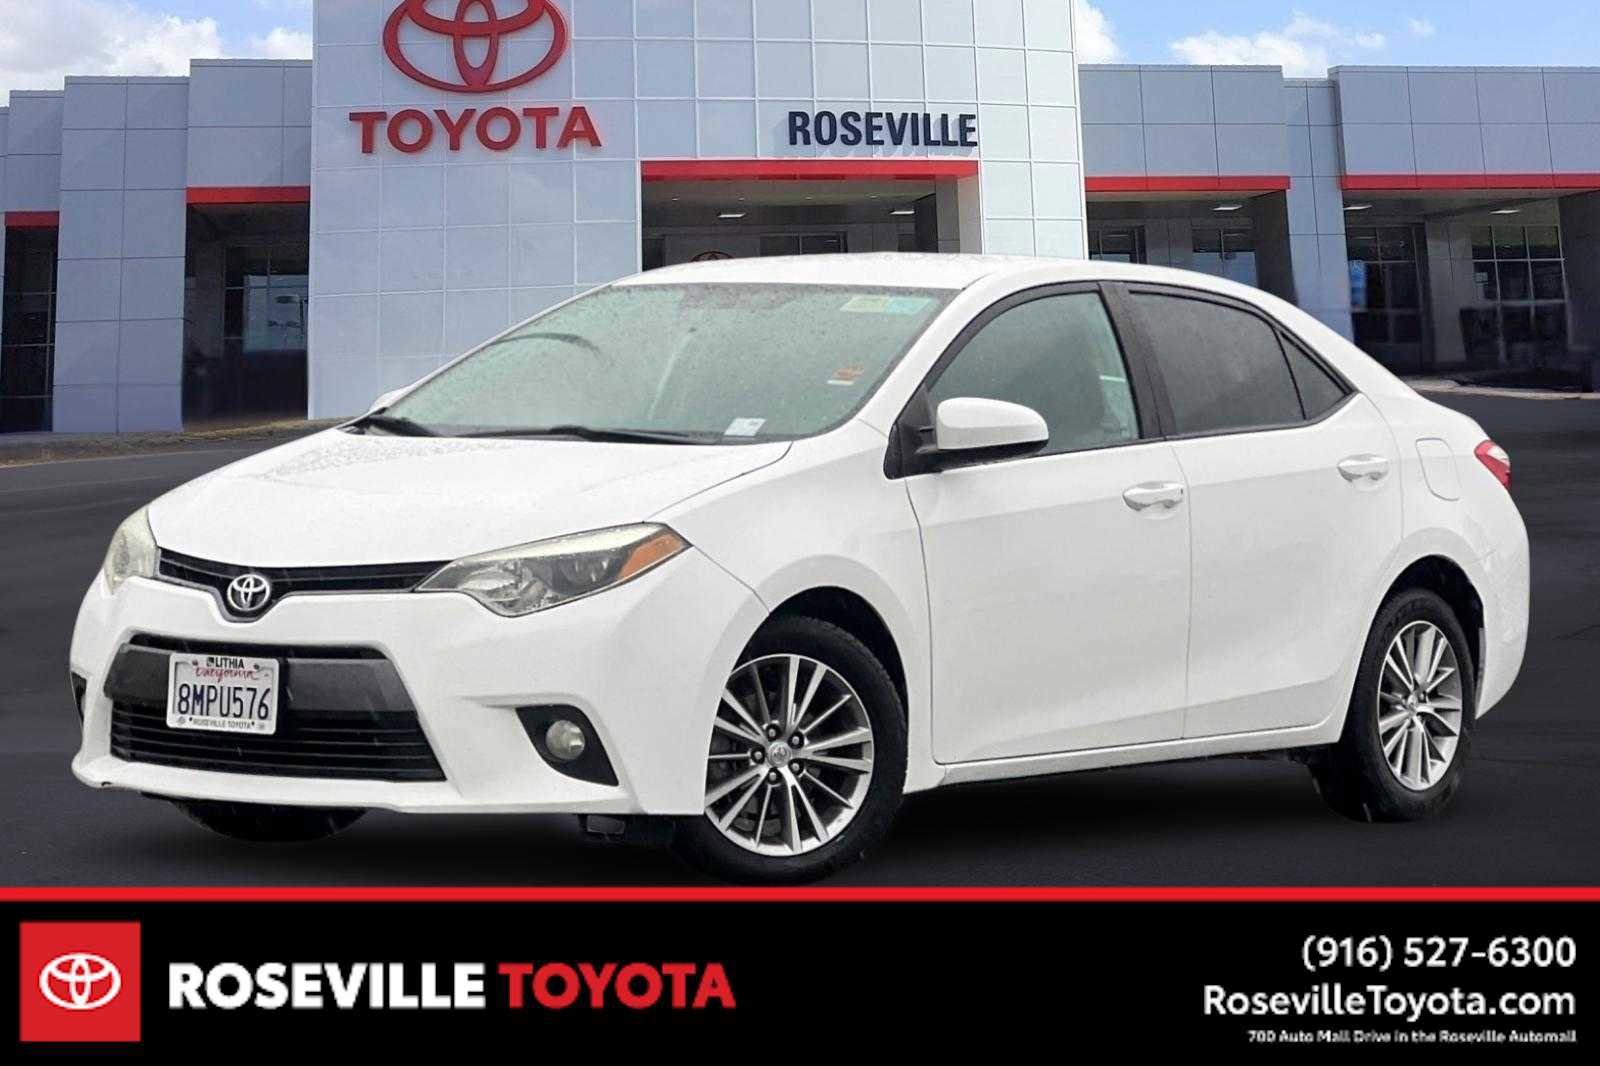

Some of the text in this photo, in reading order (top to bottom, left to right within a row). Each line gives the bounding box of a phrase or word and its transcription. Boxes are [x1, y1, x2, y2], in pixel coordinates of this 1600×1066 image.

[349, 106, 603, 154] TOYOTA
[789, 111, 978, 147] ROSEVILLE
[178, 683, 271, 720] 8MPU576
